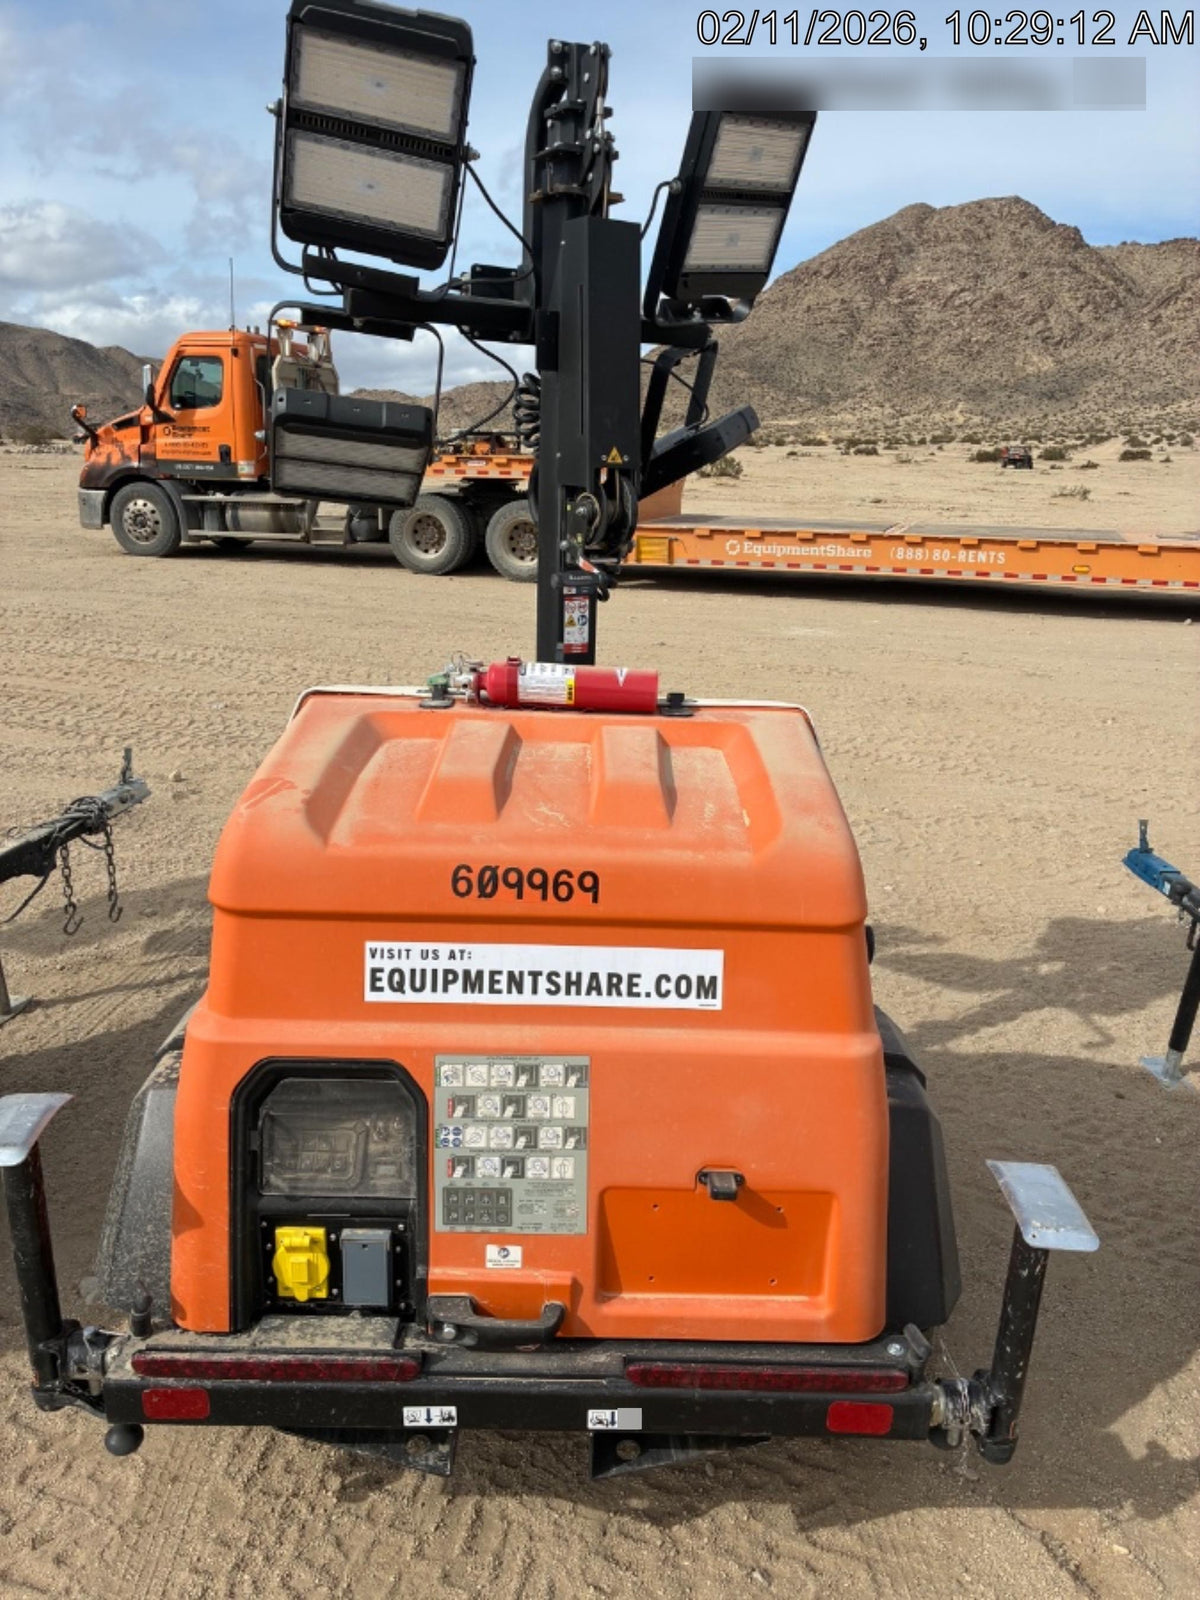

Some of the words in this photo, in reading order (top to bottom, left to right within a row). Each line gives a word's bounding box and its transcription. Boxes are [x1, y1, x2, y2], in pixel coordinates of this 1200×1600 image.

[743, 541, 872, 558] EquipmentShare
[890, 546, 929, 560] (888)
[932, 548, 1006, 564] 80-RENTS
[369, 947, 412, 960] VISIT
[420, 948, 440, 961] US
[447, 949, 472, 961] AT:
[369, 966, 718, 1000] EQUIPMENTSHARE.COM
